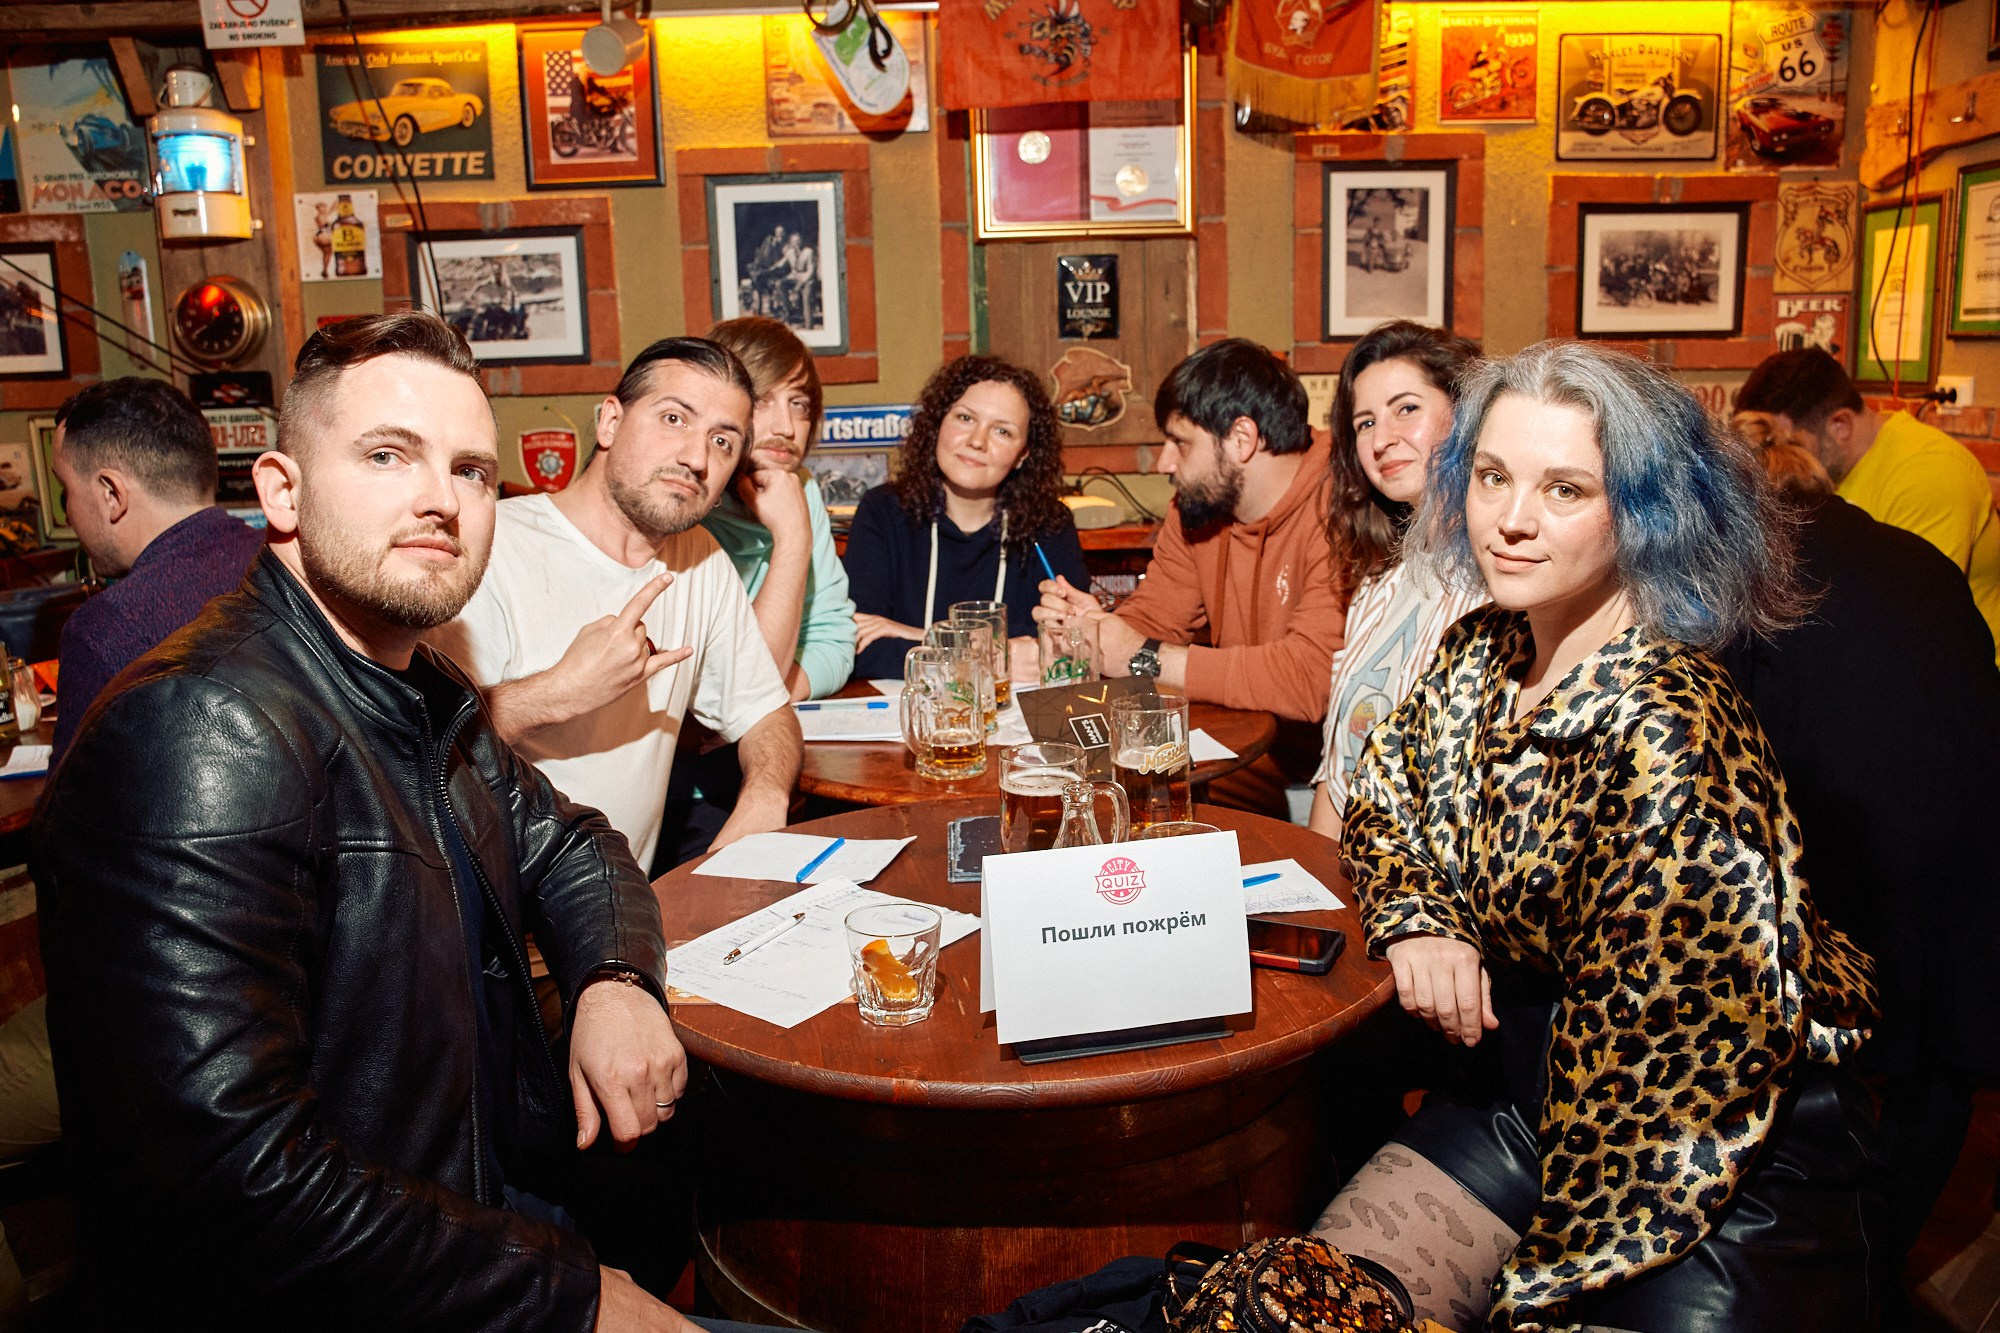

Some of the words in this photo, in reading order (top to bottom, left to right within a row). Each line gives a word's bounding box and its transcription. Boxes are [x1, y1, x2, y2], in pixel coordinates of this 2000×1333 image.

[242, 32, 277, 40] SMOKING
[1771, 17, 1806, 37] ROUTE
[1504, 32, 1536, 48] 1930
[1779, 50, 1815, 82] 66
[332, 151, 486, 180] CORVETTE
[33, 180, 142, 204] MONACO
[1065, 282, 1111, 303] VIP
[1066, 307, 1111, 319] LOUNGE
[1778, 299, 1843, 318] BEER
[821, 413, 914, 440] rtstraße
[1106, 860, 1131, 873] CITY
[1102, 875, 1139, 888] QUIZ
[1041, 924, 1116, 944] Пошли
[1122, 911, 1206, 934] пожрём
